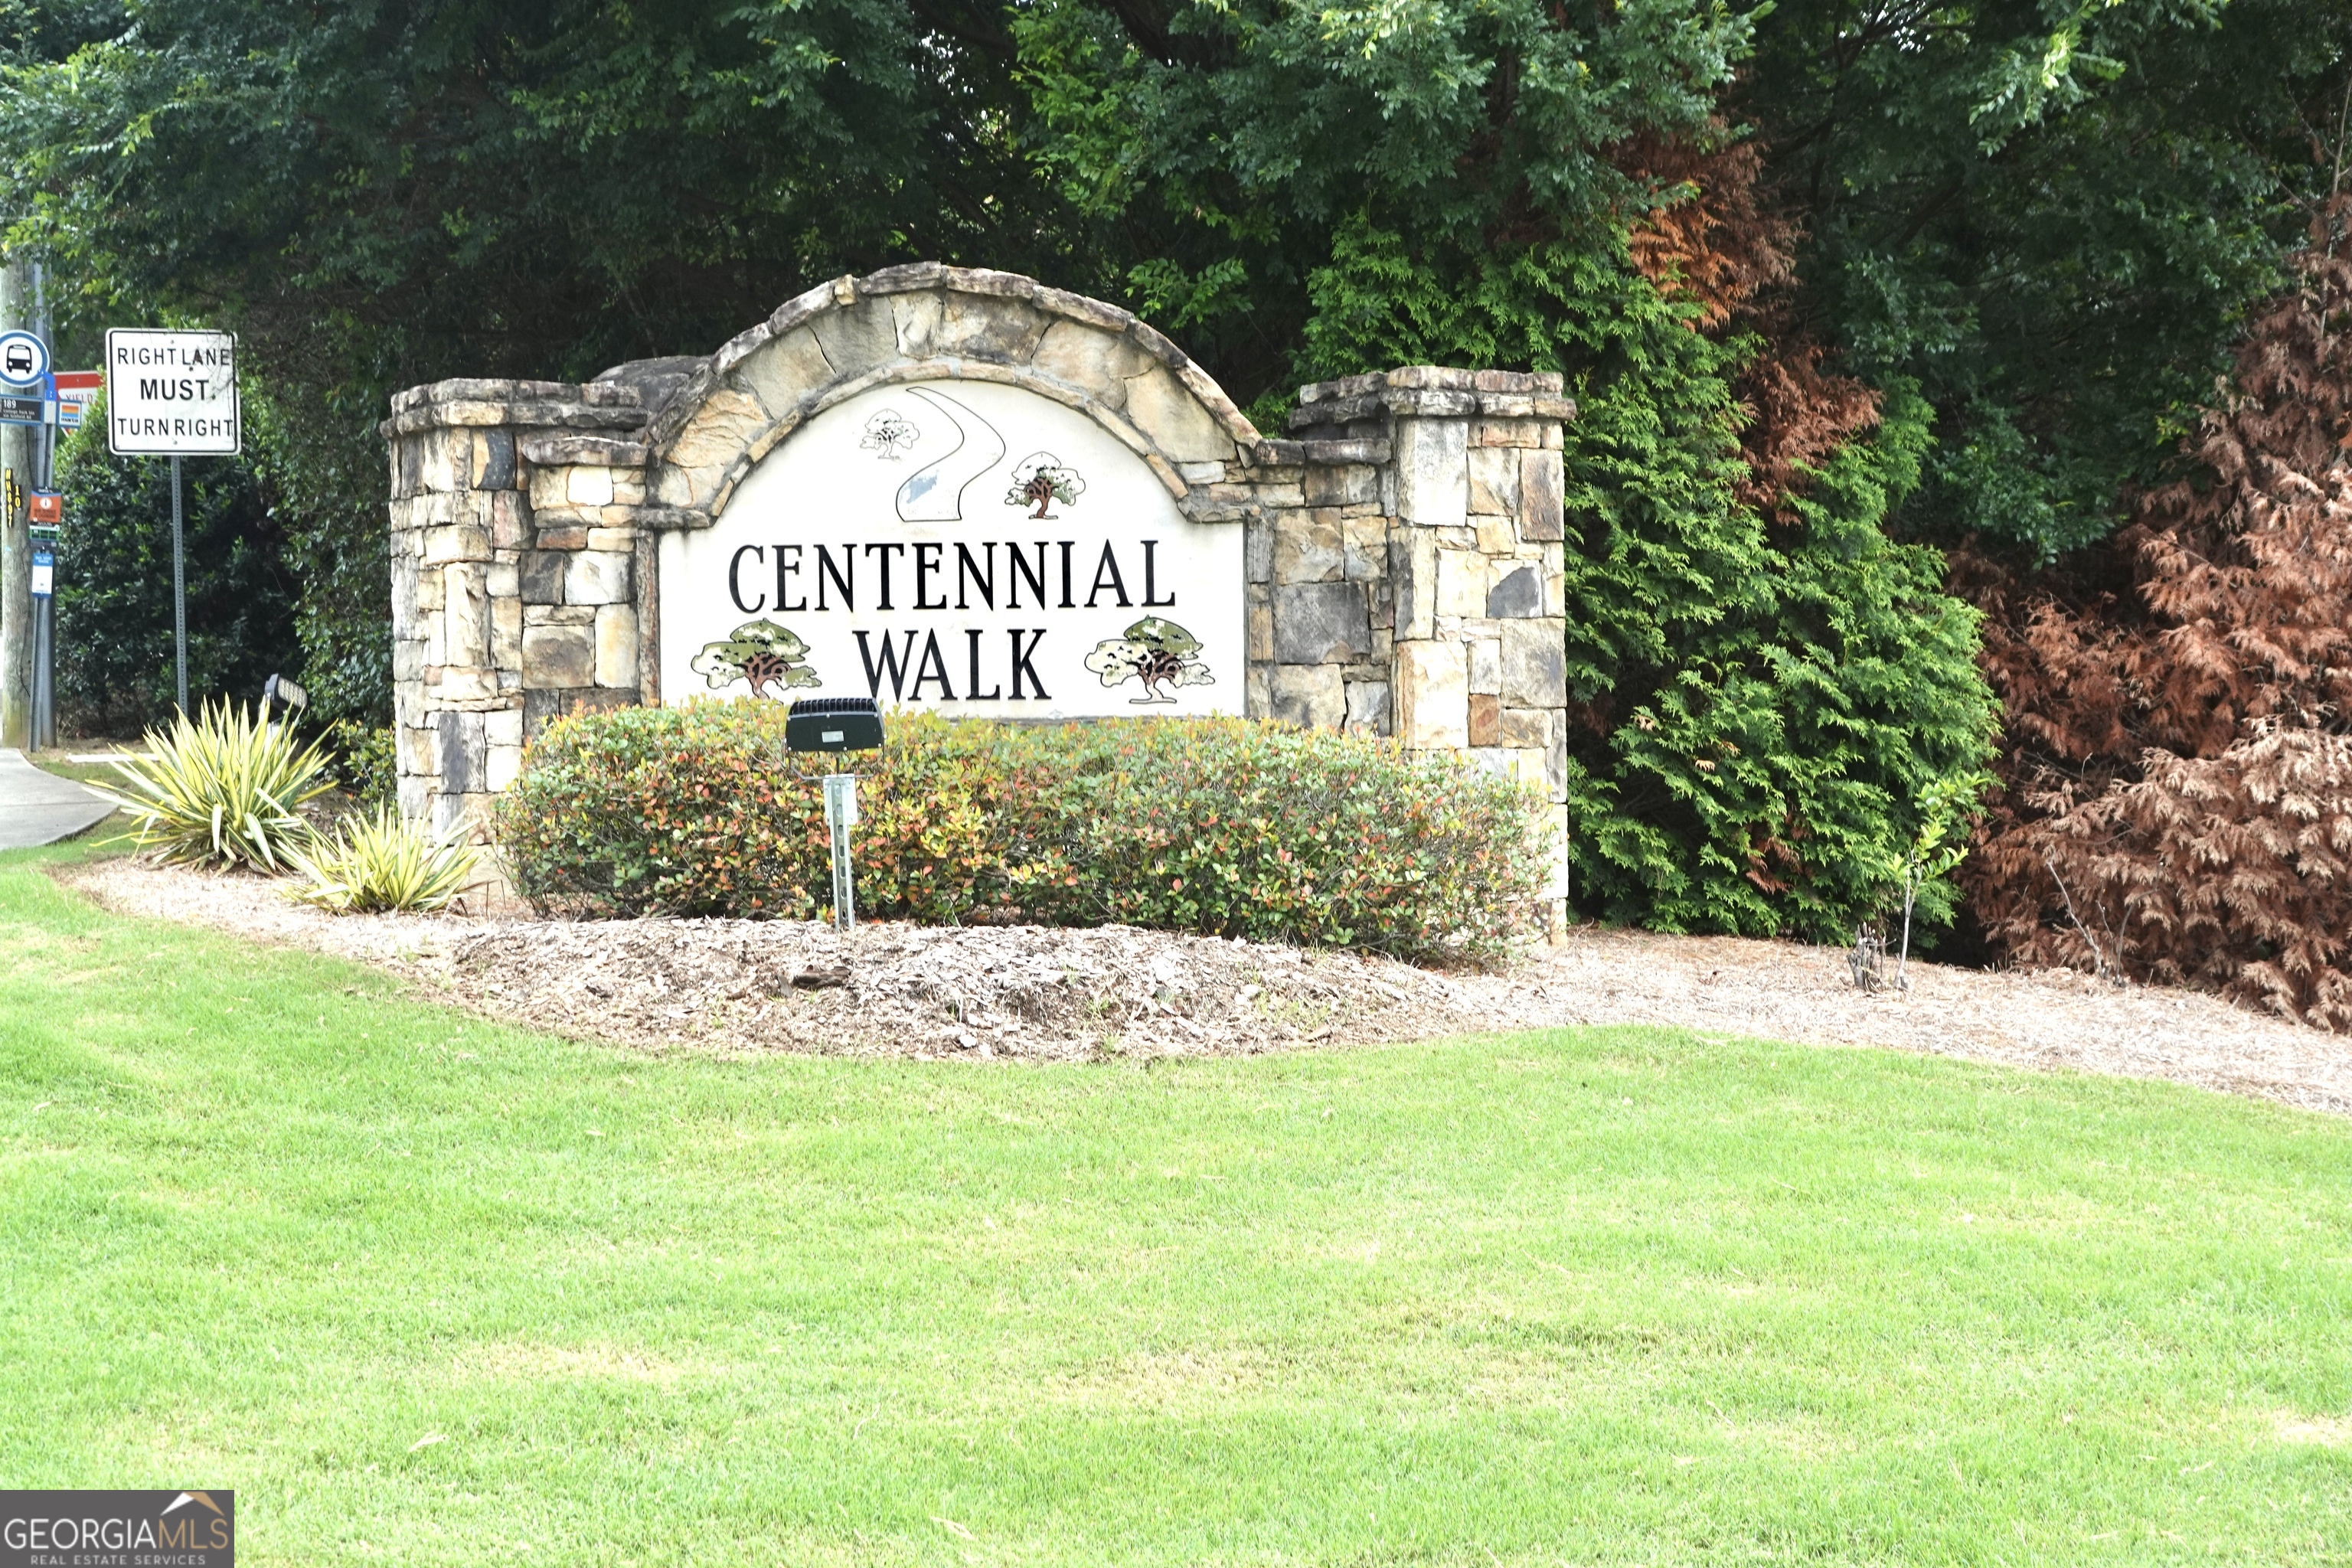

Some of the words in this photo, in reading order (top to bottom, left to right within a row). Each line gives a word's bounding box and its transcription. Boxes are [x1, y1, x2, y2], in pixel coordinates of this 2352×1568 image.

[118, 348, 176, 365] RIGHT
[181, 348, 230, 366] LANE
[66, 393, 93, 403] YIELD
[141, 379, 209, 400] MUST
[3, 399, 16, 409] 189
[117, 418, 169, 436] TURN
[175, 419, 233, 437] RIGHT
[728, 539, 1176, 613] CENTENNIAL
[851, 628, 1052, 701] WALK
